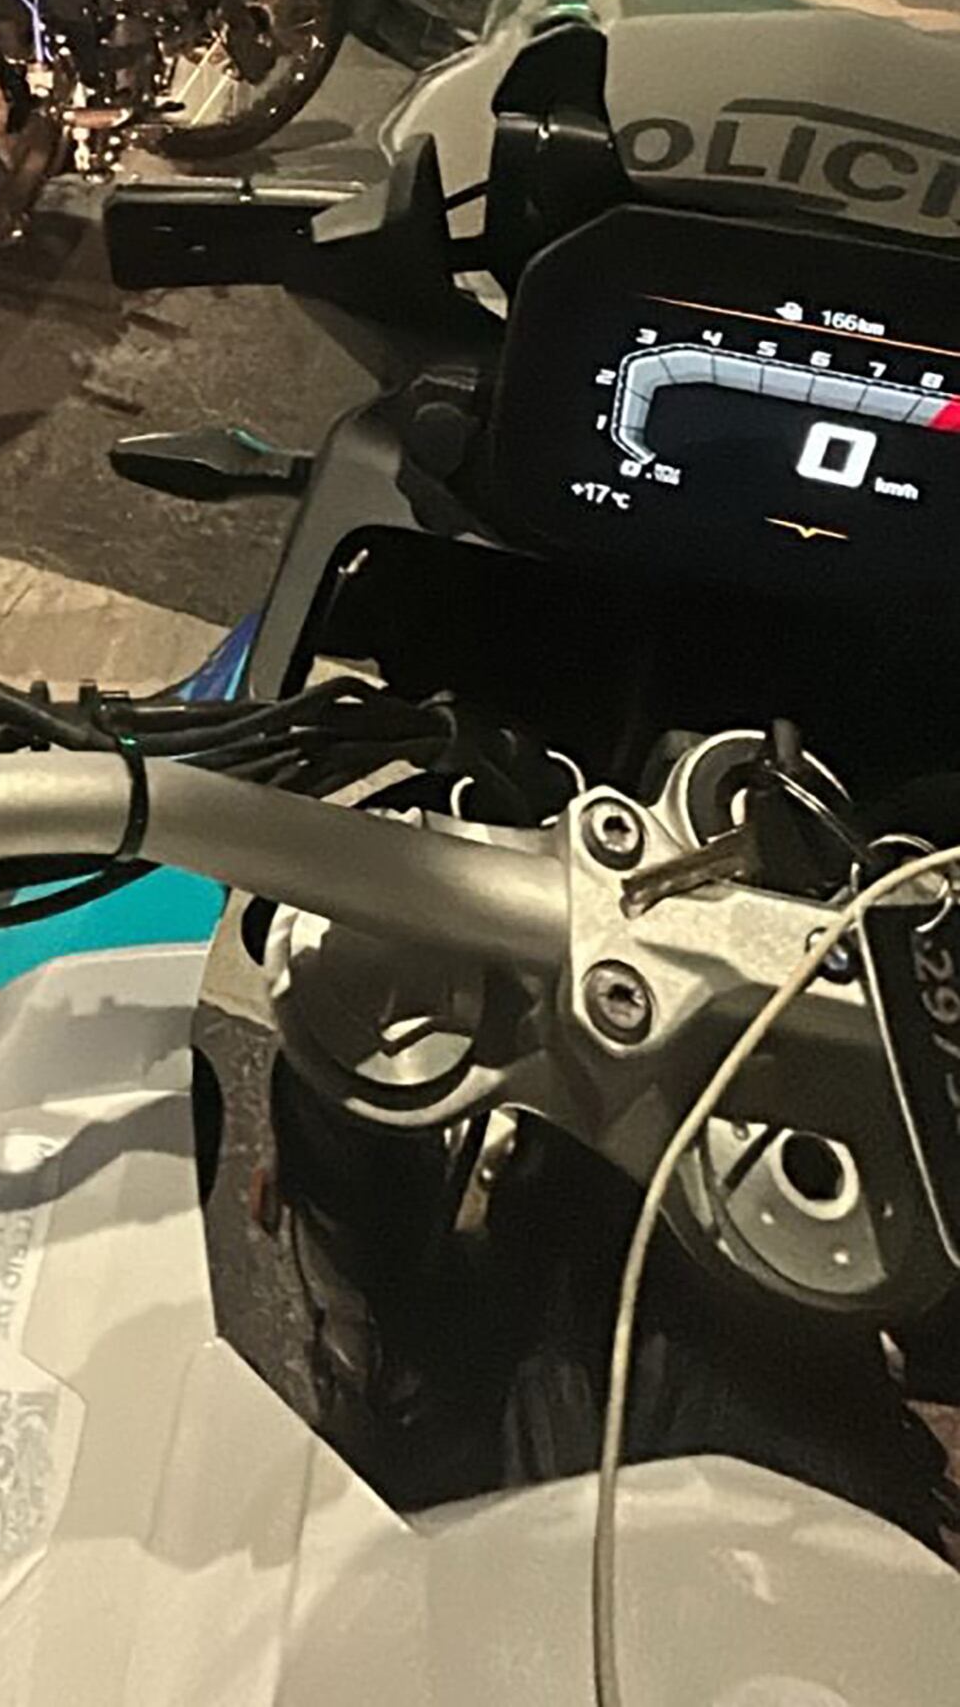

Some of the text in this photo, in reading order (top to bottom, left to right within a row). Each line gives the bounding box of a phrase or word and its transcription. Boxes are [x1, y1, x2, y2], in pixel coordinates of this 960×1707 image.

[635, 327, 658, 345] 3
[702, 329, 724, 347] 4
[756, 340, 778, 358] 5
[809, 350, 833, 369] 6
[868, 361, 888, 379] 7
[595, 368, 617, 386] 2
[596, 414, 608, 431] 1
[795, 420, 878, 490] 0
